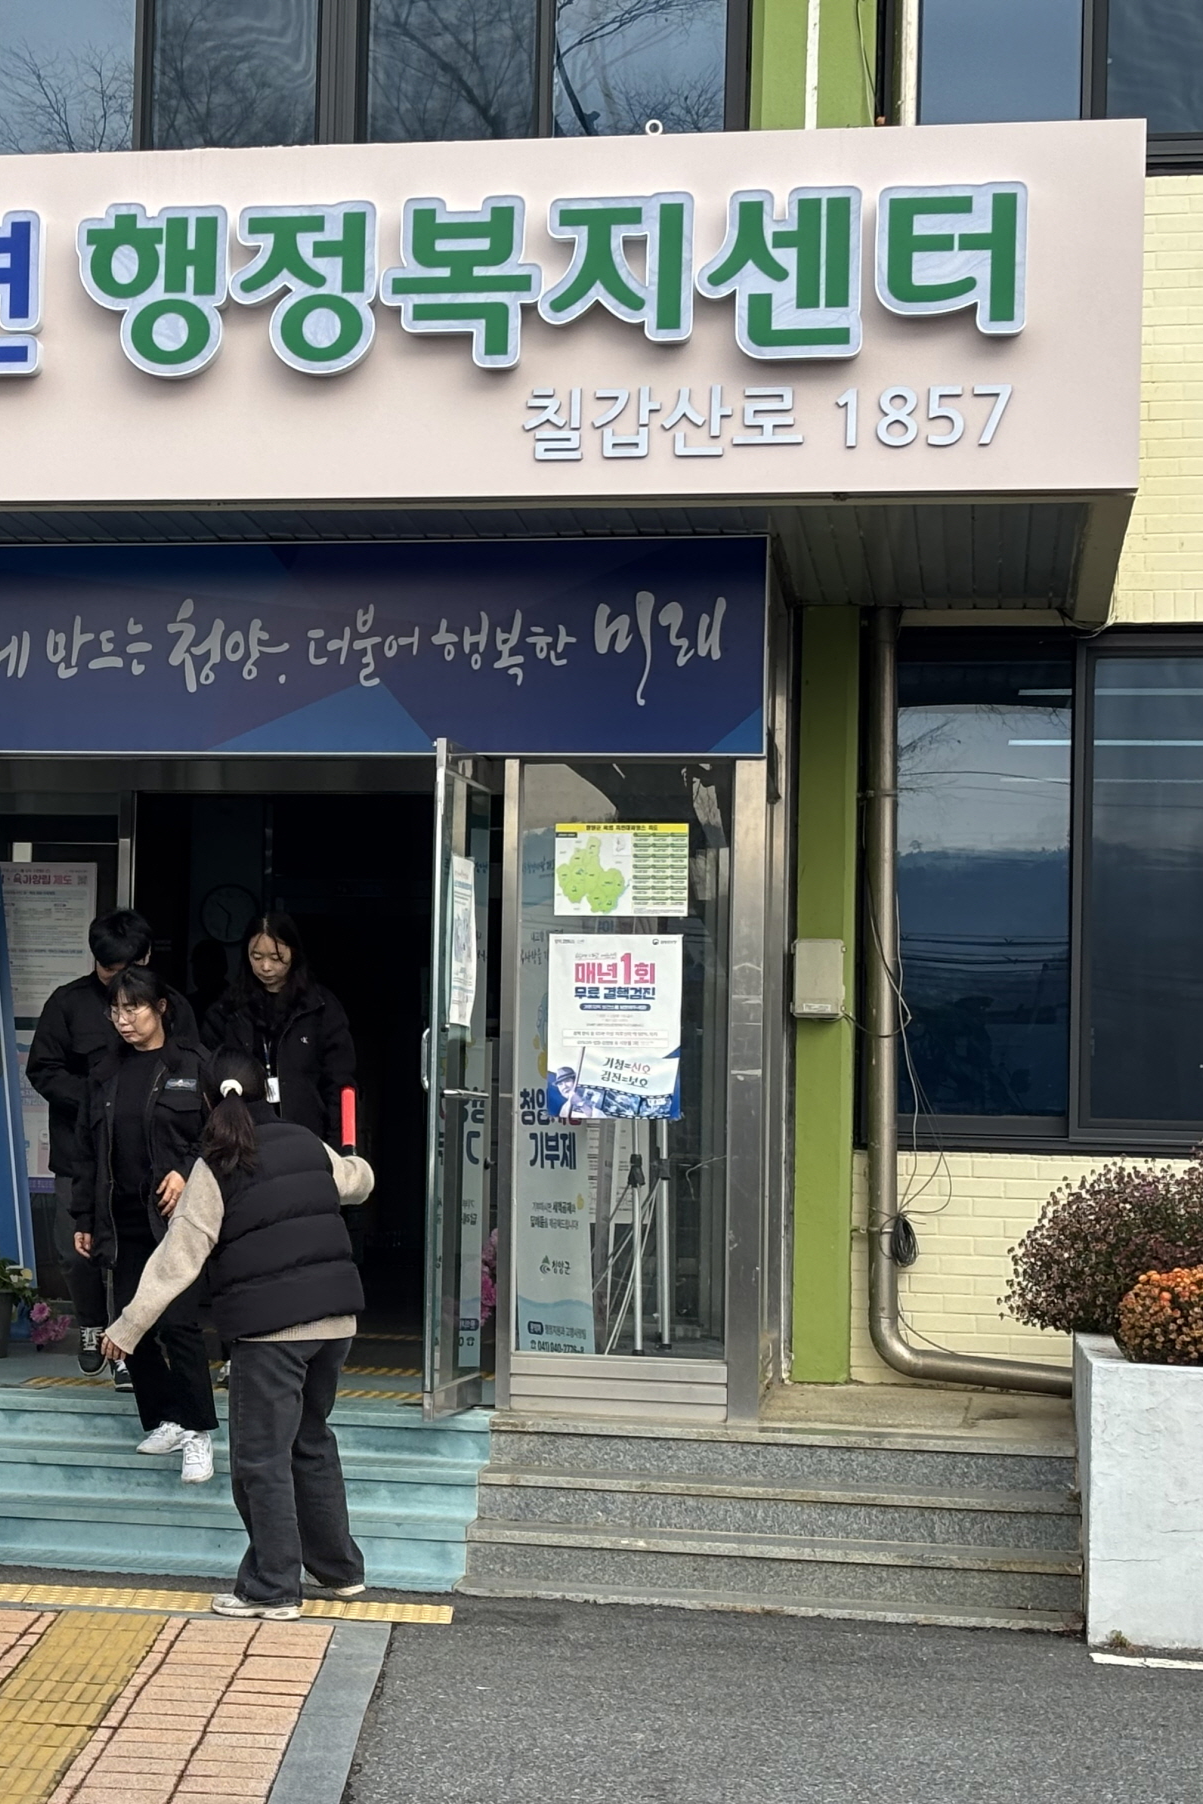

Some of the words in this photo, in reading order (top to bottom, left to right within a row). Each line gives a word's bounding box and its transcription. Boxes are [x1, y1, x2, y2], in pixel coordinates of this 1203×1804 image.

[82, 187, 1023, 370] 행정복지센터
[524, 388, 804, 461] 칠갑산로
[835, 385, 1013, 447] 1857
[47, 615, 152, 679] 만드는
[307, 604, 419, 688] 더불어
[431, 609, 577, 687] 행복한
[594, 591, 727, 707] 미래
[574, 986, 600, 999] 무료
[604, 986, 655, 1000] 결핵검진
[529, 1131, 576, 1170] 기부제
